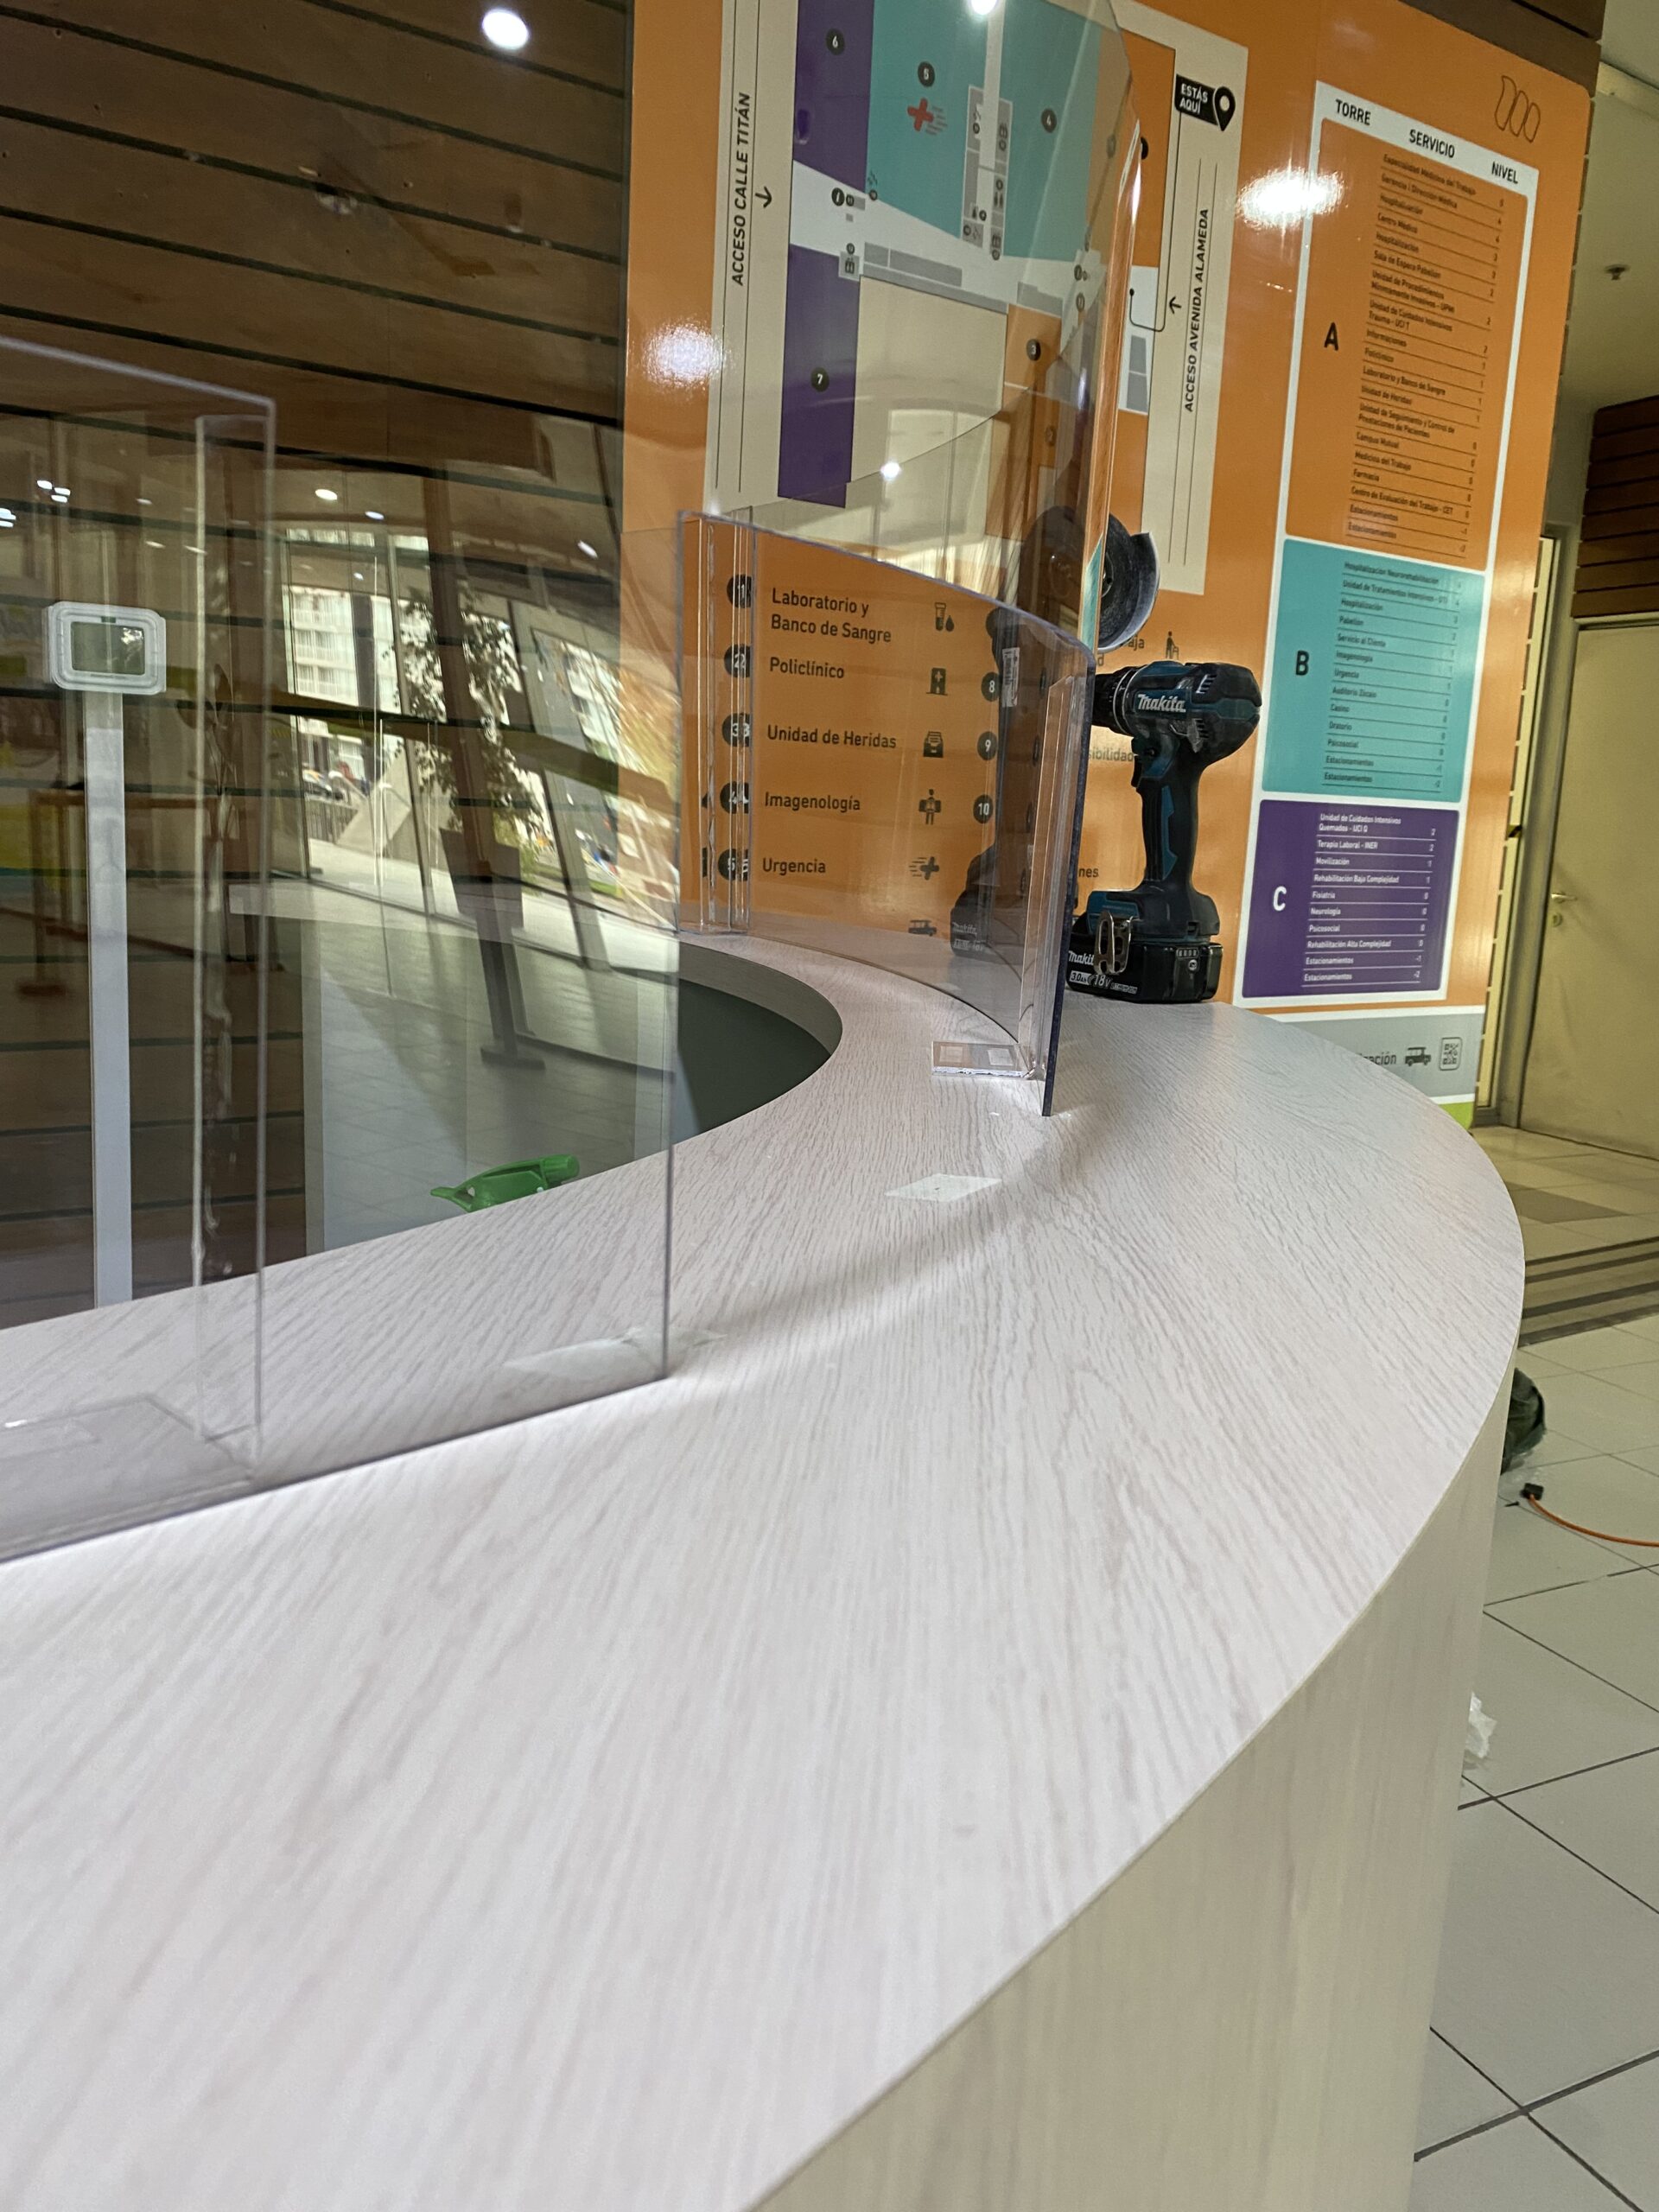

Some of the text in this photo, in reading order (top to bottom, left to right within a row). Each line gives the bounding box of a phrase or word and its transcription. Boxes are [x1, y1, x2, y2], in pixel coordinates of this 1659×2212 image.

[832, 35, 838, 48] 6
[1180, 83, 1208, 103] ESTÁS
[1179, 97, 1201, 114] AQUÍ
[1335, 99, 1371, 126] TORRE
[1046, 114, 1052, 125] 4
[1409, 129, 1455, 158] SERVICIO
[1491, 161, 1519, 184] NIVEL
[732, 92, 750, 286] ACCESO CALLE TITÁN
[1185, 209, 1209, 412] ACCESO AVENIDA ALAMEDA
[1324, 322, 1339, 352] A
[817, 373, 823, 385] 7
[1363, 365, 1395, 382] Laboratorio
[772, 588, 869, 618] Laboratorio y
[772, 613, 891, 644] Banco de Sangre
[1128, 635, 1145, 651] aja
[770, 657, 844, 678] Policlínico
[1296, 650, 1310, 676] B
[988, 680, 995, 692] 8
[767, 724, 897, 748] Unidad de Heridas
[985, 740, 991, 752] 9
[765, 791, 861, 813] Imagenología
[978, 803, 989, 815] 10
[1348, 814, 1374, 823] Cuidados
[1319, 823, 1348, 832] Quemados
[1317, 840, 1338, 849] Terapia
[762, 857, 826, 876] Urgencia
[1315, 856, 1350, 865] Movilización
[1313, 874, 1353, 882] Rehabilitación
[1366, 875, 1399, 884] Complejidad
[1273, 886, 1287, 912] C
[1310, 907, 1341, 916] Neurología
[1309, 924, 1340, 932] Psicosocial
[1306, 940, 1345, 949] Rehabilitación
[1306, 957, 1354, 965] Estacionamientos
[1094, 974, 1113, 988] 18V
[1304, 973, 1352, 982] Estacionamientos
